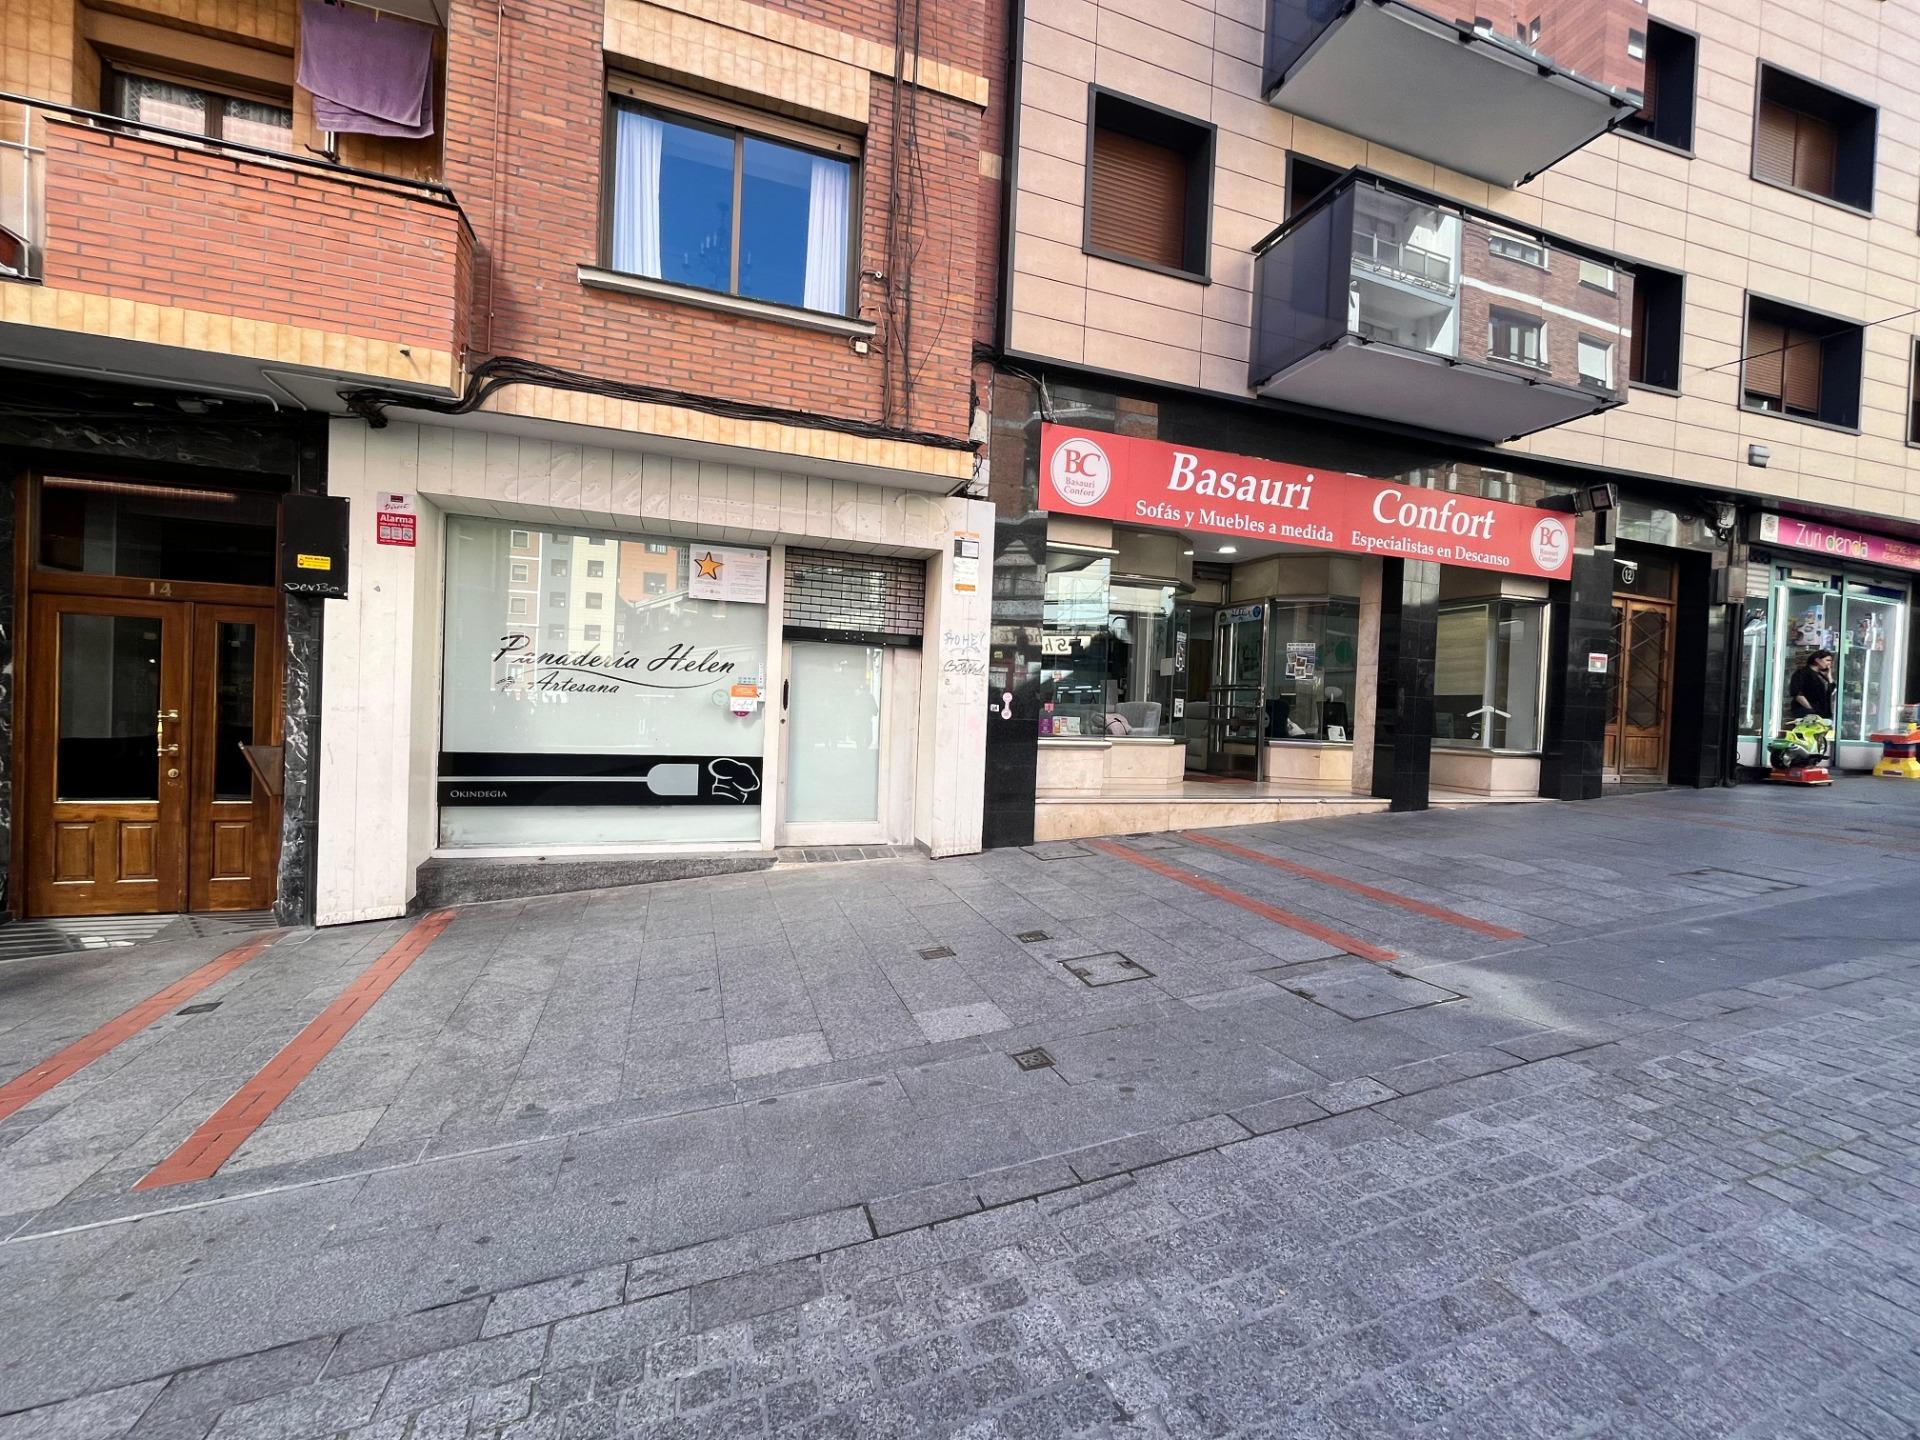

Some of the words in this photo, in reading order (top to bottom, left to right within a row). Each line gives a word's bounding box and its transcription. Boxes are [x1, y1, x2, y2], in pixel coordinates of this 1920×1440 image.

[1064, 448, 1101, 477] BC
[1063, 485, 1096, 497] Confort
[1065, 476, 1096, 488] Basauri
[1167, 451, 1315, 511] Basauri
[1372, 488, 1496, 540] Confort
[380, 514, 414, 524] Alarma
[1135, 499, 1181, 521] Sofás
[1184, 510, 1195, 528] y
[1199, 508, 1265, 533] Muebles
[1268, 521, 1277, 535] a
[1280, 522, 1334, 543] medida
[1351, 530, 1435, 556] Especialistas
[1436, 545, 1452, 559] en
[1454, 545, 1511, 567] Descanso
[1540, 526, 1563, 548] BC
[1795, 523, 1822, 548] Zuri
[1825, 530, 1869, 558] denda
[1624, 569, 1632, 580] 12
[150, 581, 172, 597] 14
[646, 643, 736, 674] Helen
[535, 670, 621, 694] Artesana
